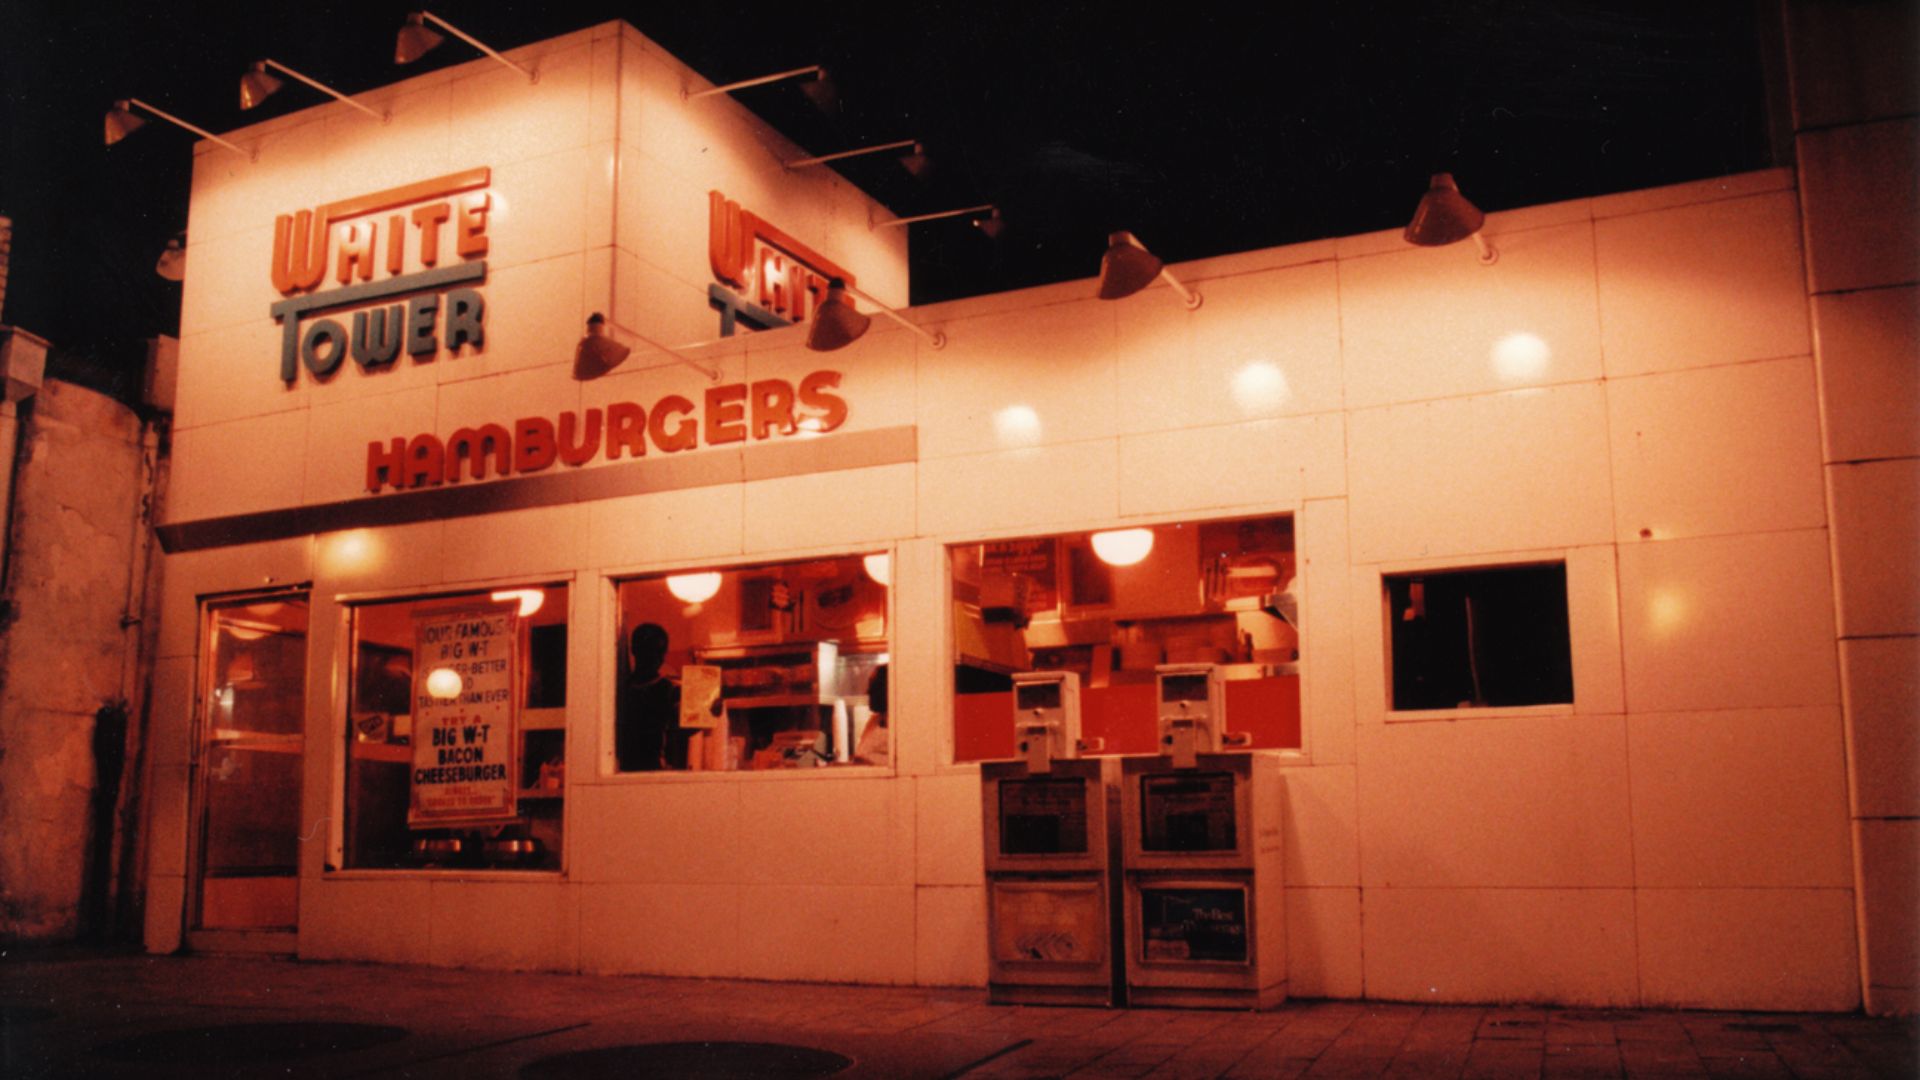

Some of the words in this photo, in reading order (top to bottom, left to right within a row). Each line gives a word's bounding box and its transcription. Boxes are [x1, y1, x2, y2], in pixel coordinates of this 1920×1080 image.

[271, 166, 491, 297] WHITE
[708, 189, 857, 323] WHIT
[270, 260, 487, 391] TOWER
[366, 369, 848, 493] HAMBURGERS
[414, 763, 507, 785] CHEESEBURGER
[432, 726, 457, 747] BIG
[463, 723, 491, 745] W-T
[438, 746, 484, 765] BACON
